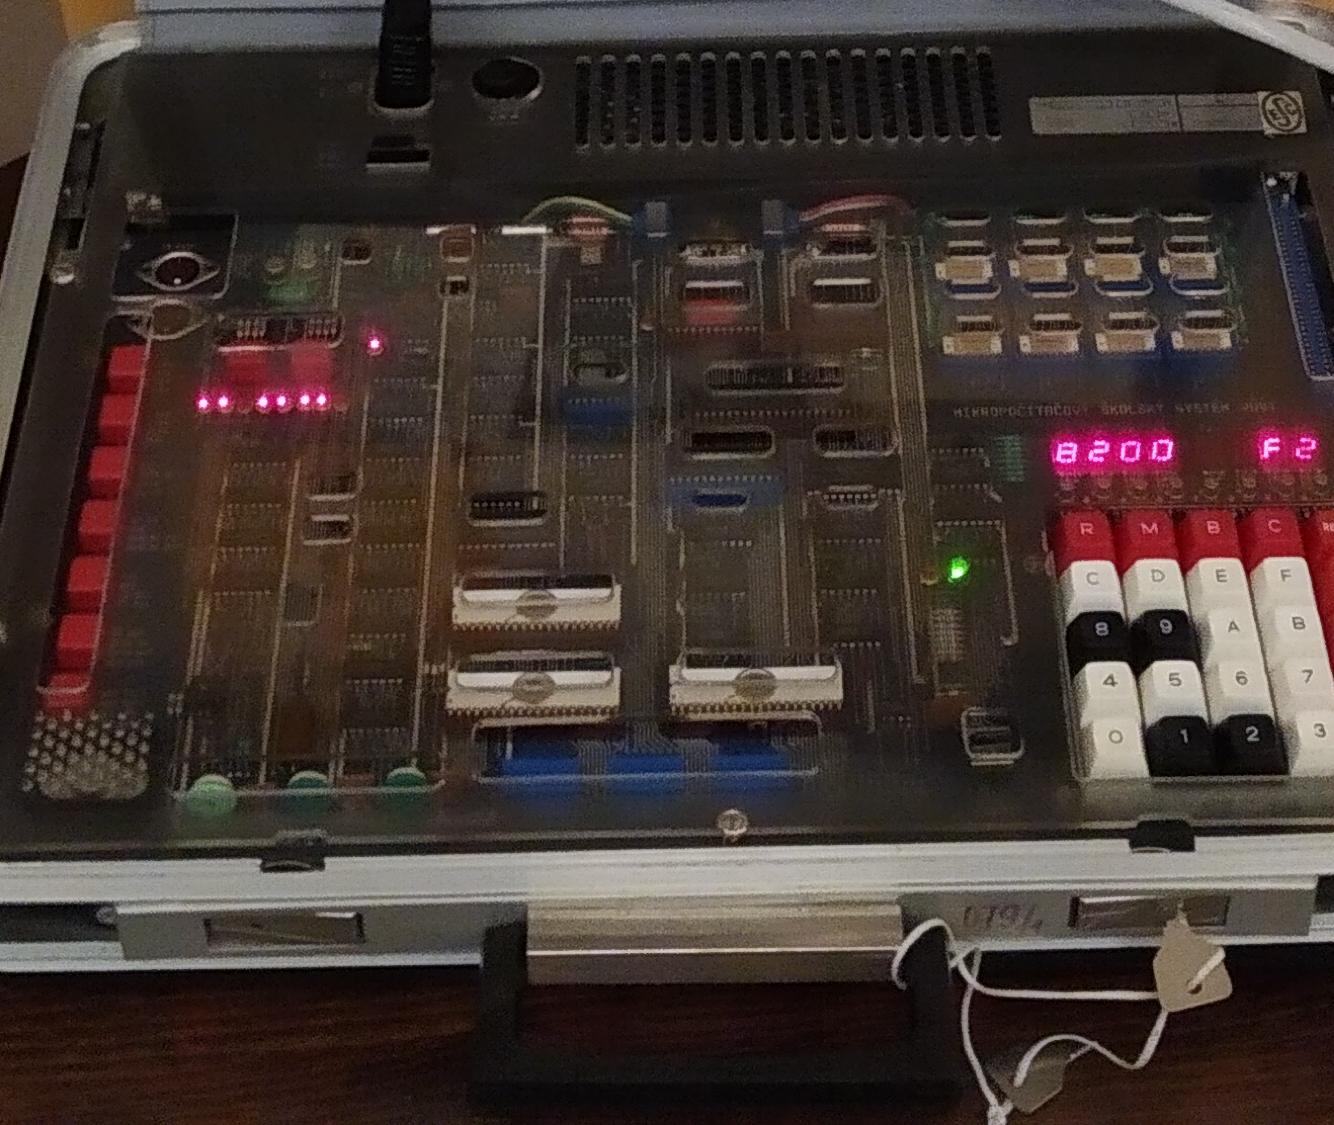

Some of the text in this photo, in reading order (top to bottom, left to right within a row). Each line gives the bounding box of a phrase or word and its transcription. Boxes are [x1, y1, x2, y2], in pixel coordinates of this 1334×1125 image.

[1080, 522, 1094, 535] R
[1141, 522, 1159, 535] M
[1206, 521, 1221, 534] B
[1267, 519, 1283, 533] C
[1086, 571, 1099, 585] C
[1151, 569, 1165, 583] D
[1216, 568, 1228, 583] E
[1280, 568, 1292, 582] F
[1095, 621, 1110, 636] 8
[1160, 619, 1174, 634] 9
[1227, 621, 1241, 634] A
[1292, 616, 1306, 630] B
[1102, 674, 1118, 687] 4
[1168, 672, 1182, 686] 5
[1235, 671, 1248, 685] 6
[1301, 669, 1314, 684] 7
[1180, 729, 1189, 743] 1
[1246, 726, 1260, 742] 2
[1313, 724, 1327, 738] 3
